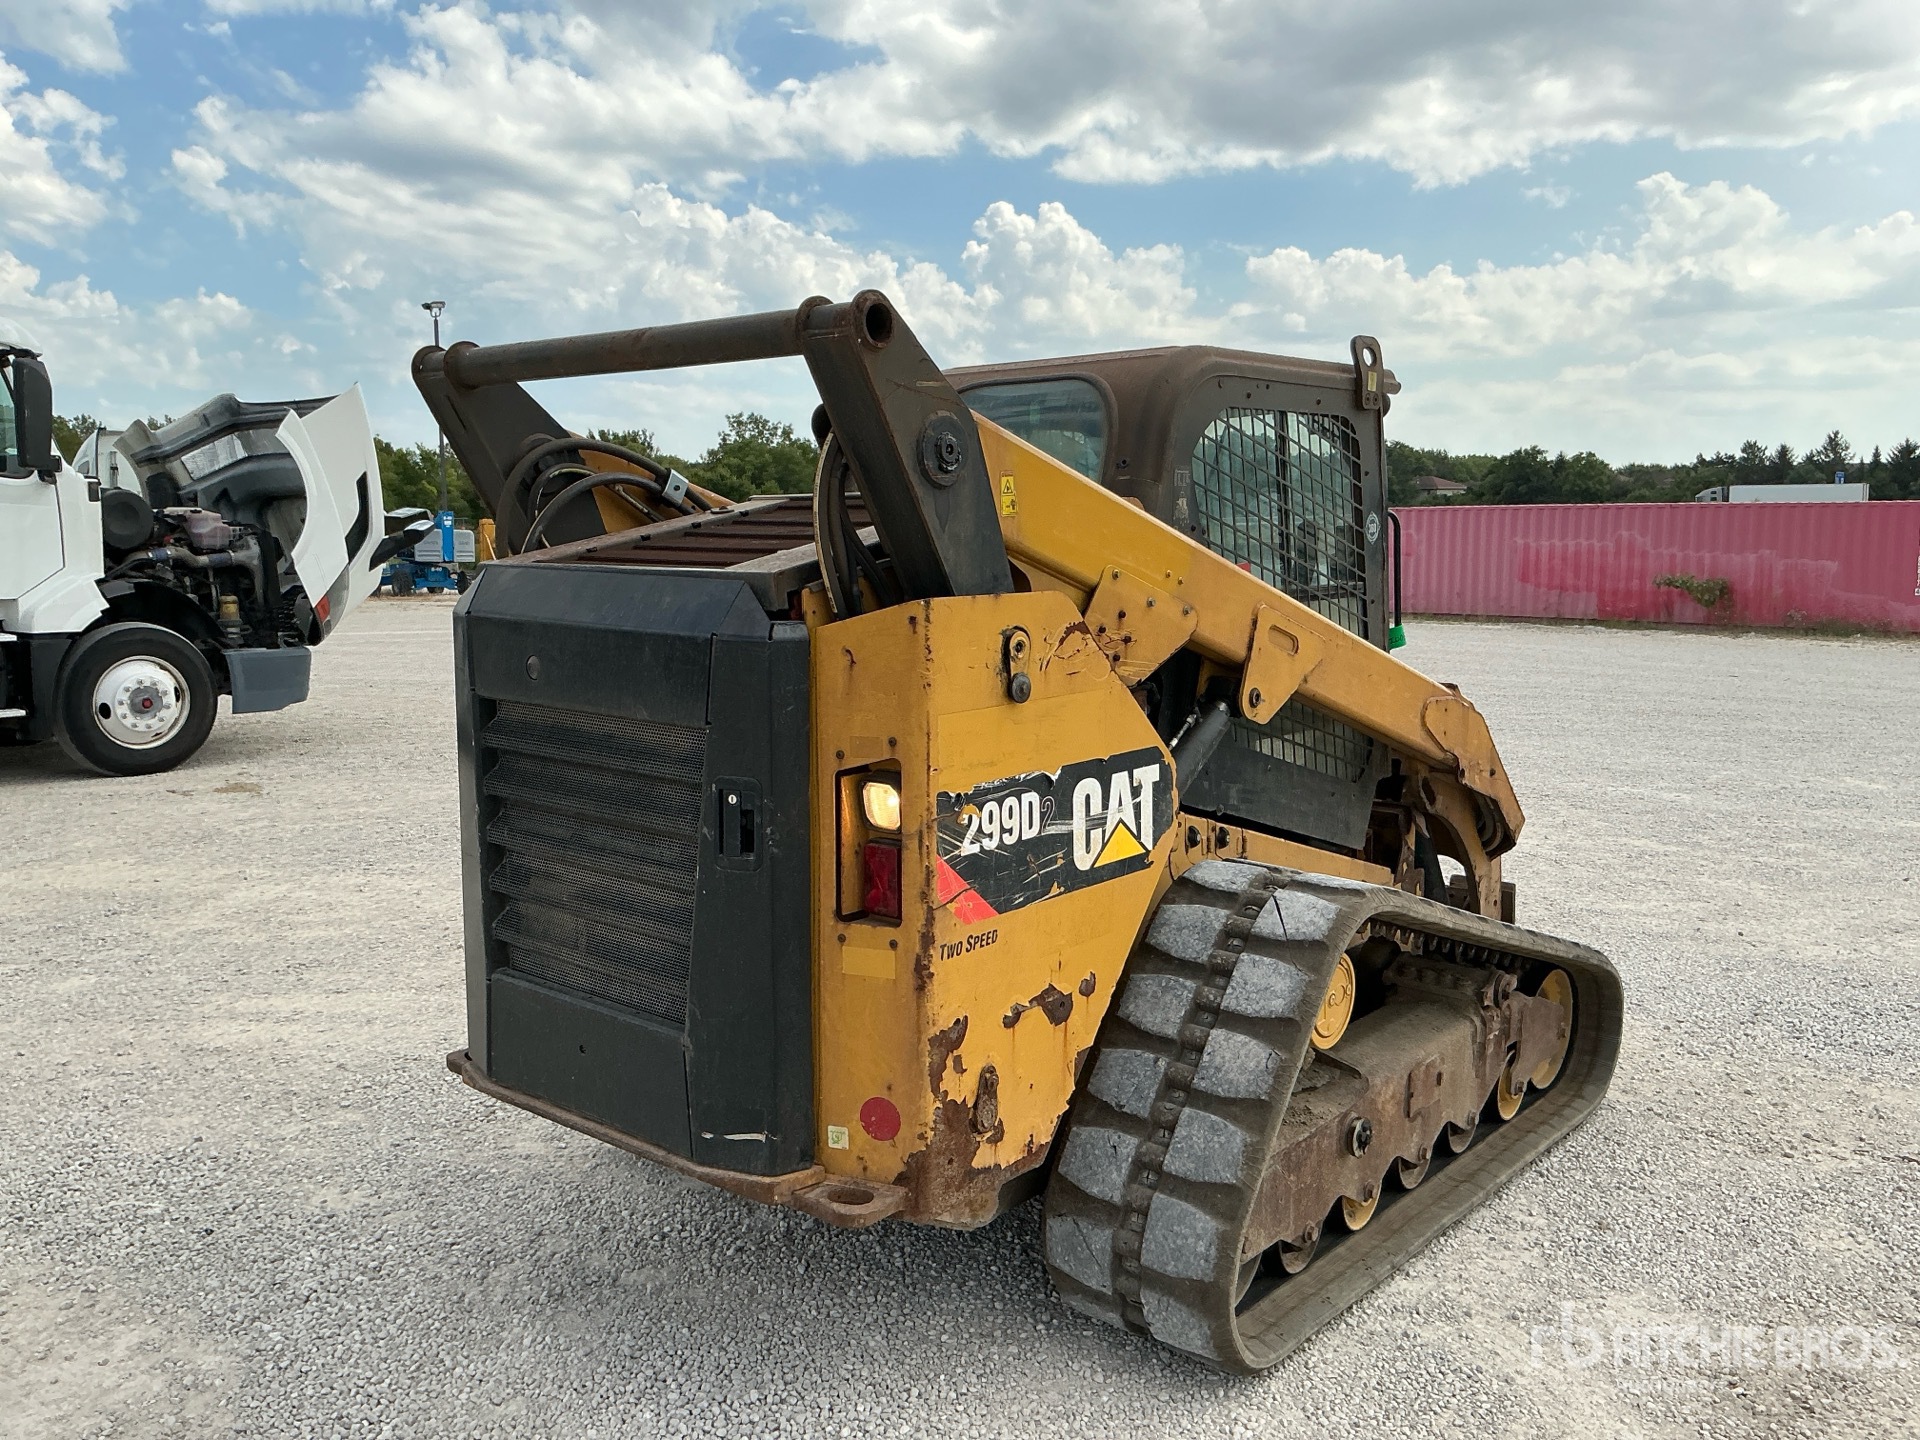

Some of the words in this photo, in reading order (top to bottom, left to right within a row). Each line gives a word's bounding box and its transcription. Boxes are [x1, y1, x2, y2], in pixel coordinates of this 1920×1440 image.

[1072, 763, 1161, 872] CAT
[939, 941, 963, 962] TWO
[965, 928, 999, 953] SPEED
